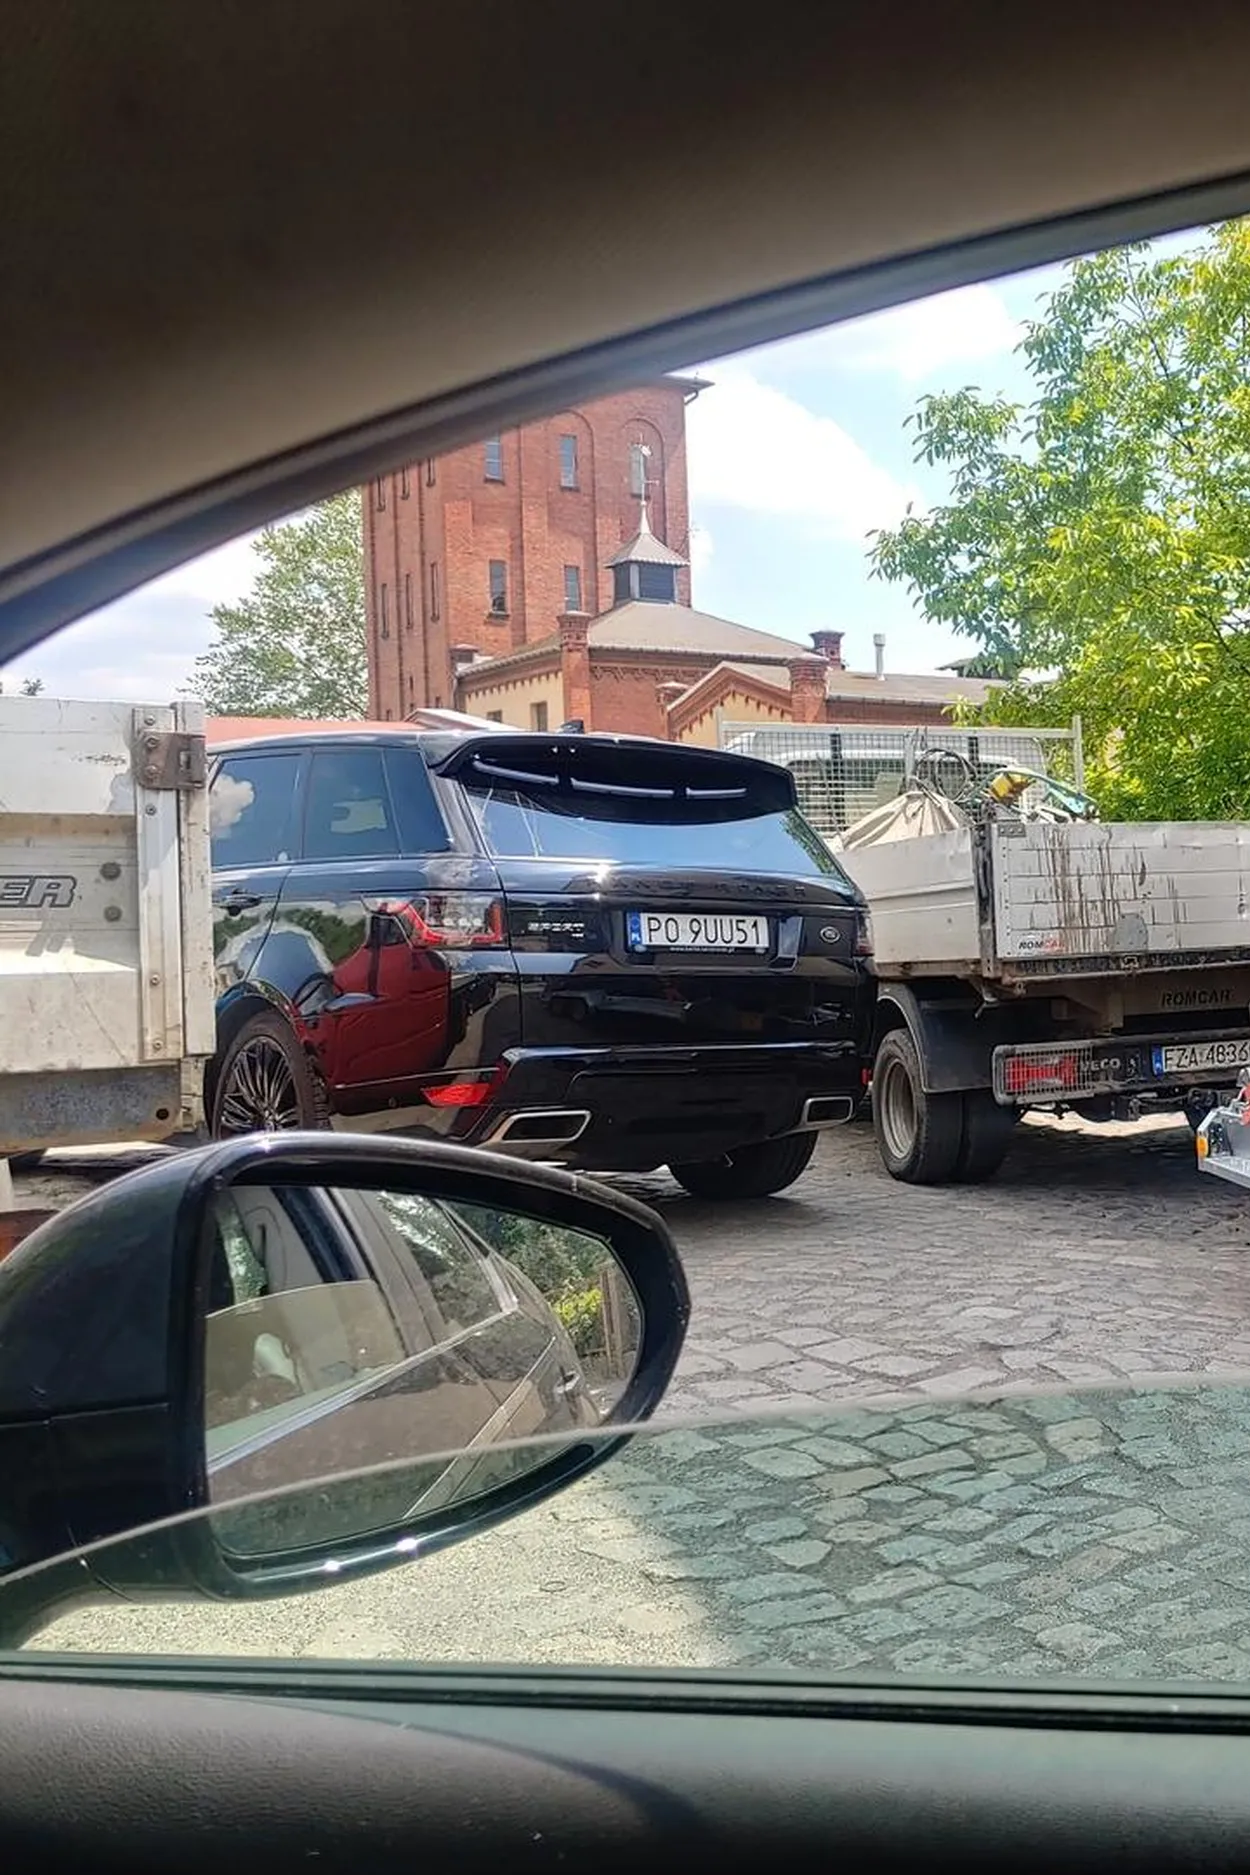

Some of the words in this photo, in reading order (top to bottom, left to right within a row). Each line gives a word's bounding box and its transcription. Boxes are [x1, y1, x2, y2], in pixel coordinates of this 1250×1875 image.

[647, 917, 680, 943] PO
[689, 918, 760, 945] 9UU51
[1164, 1047, 1198, 1071] FZA
